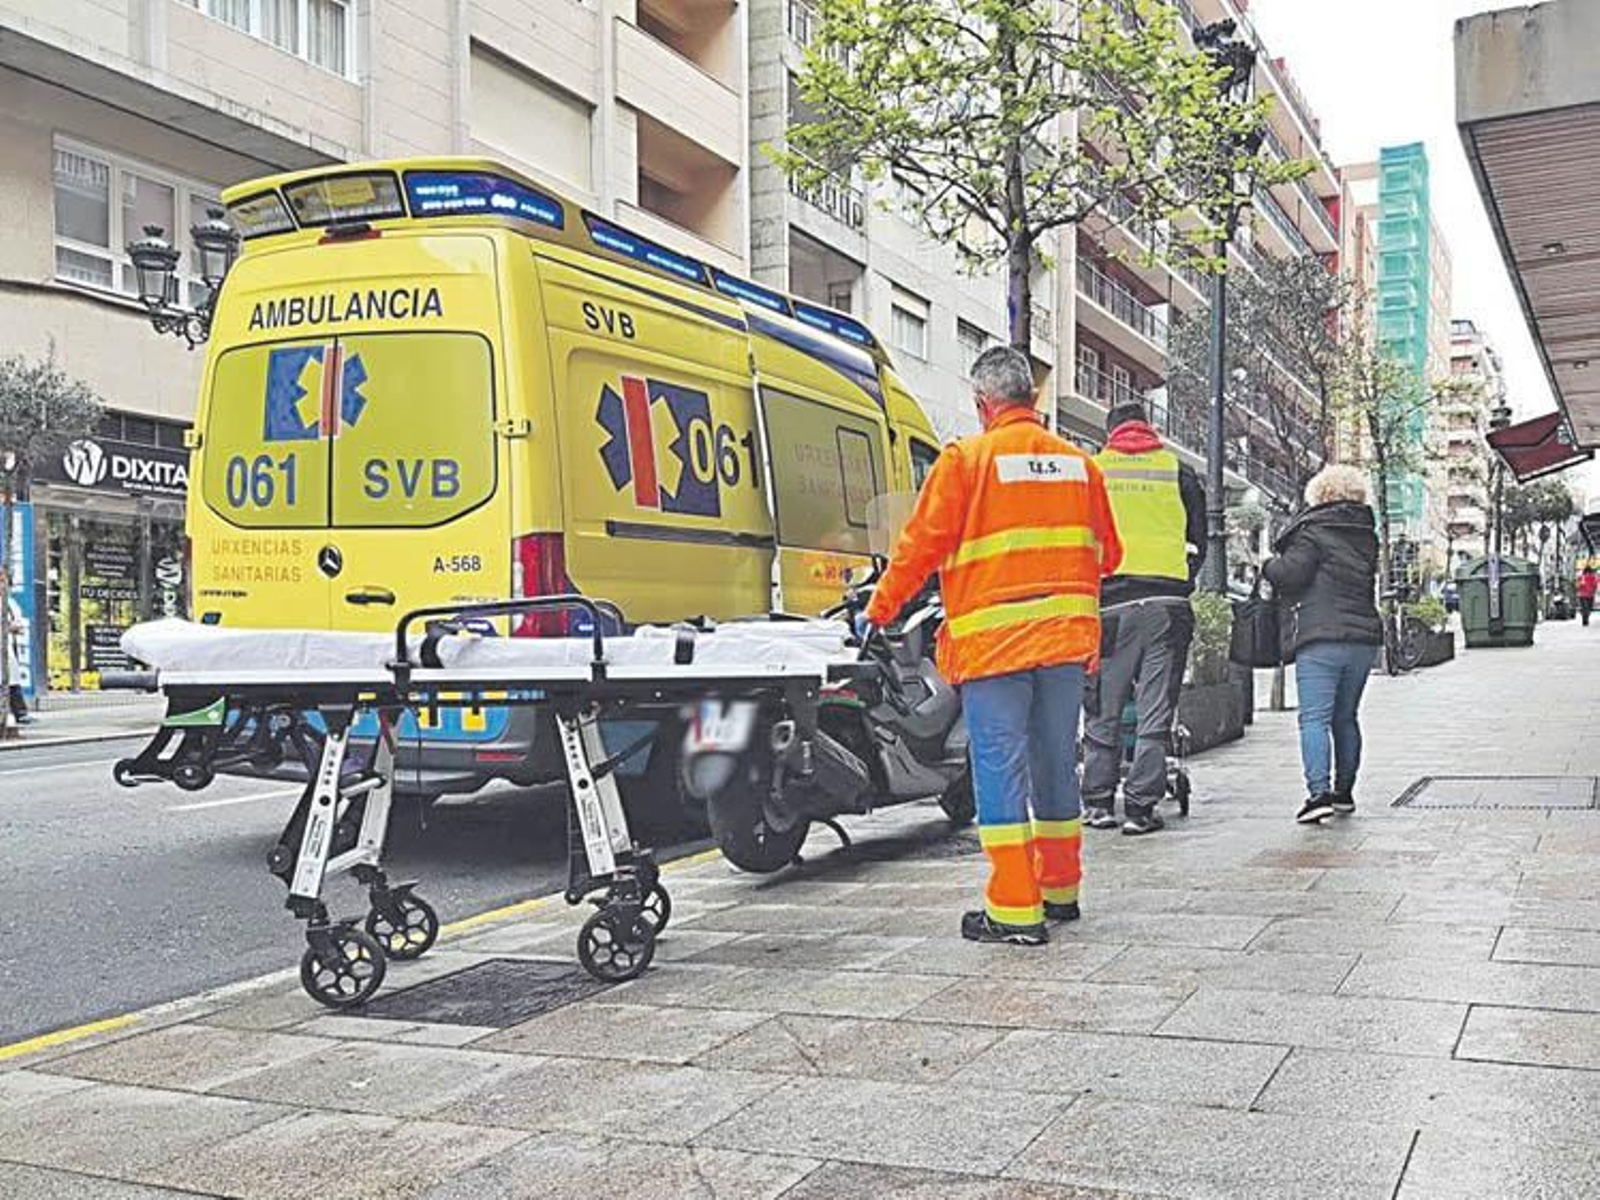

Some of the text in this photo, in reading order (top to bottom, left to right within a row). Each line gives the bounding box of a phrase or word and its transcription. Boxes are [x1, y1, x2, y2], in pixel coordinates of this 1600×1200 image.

[248, 287, 443, 331] AMBULANCIA
[582, 301, 635, 339] SVB
[688, 417, 759, 489] 061
[226, 453, 297, 508] 061
[363, 458, 461, 499] SVB
[212, 538, 302, 556] URXENCIAS
[432, 555, 482, 574] A-568
[212, 565, 302, 582] SANITARIAS
